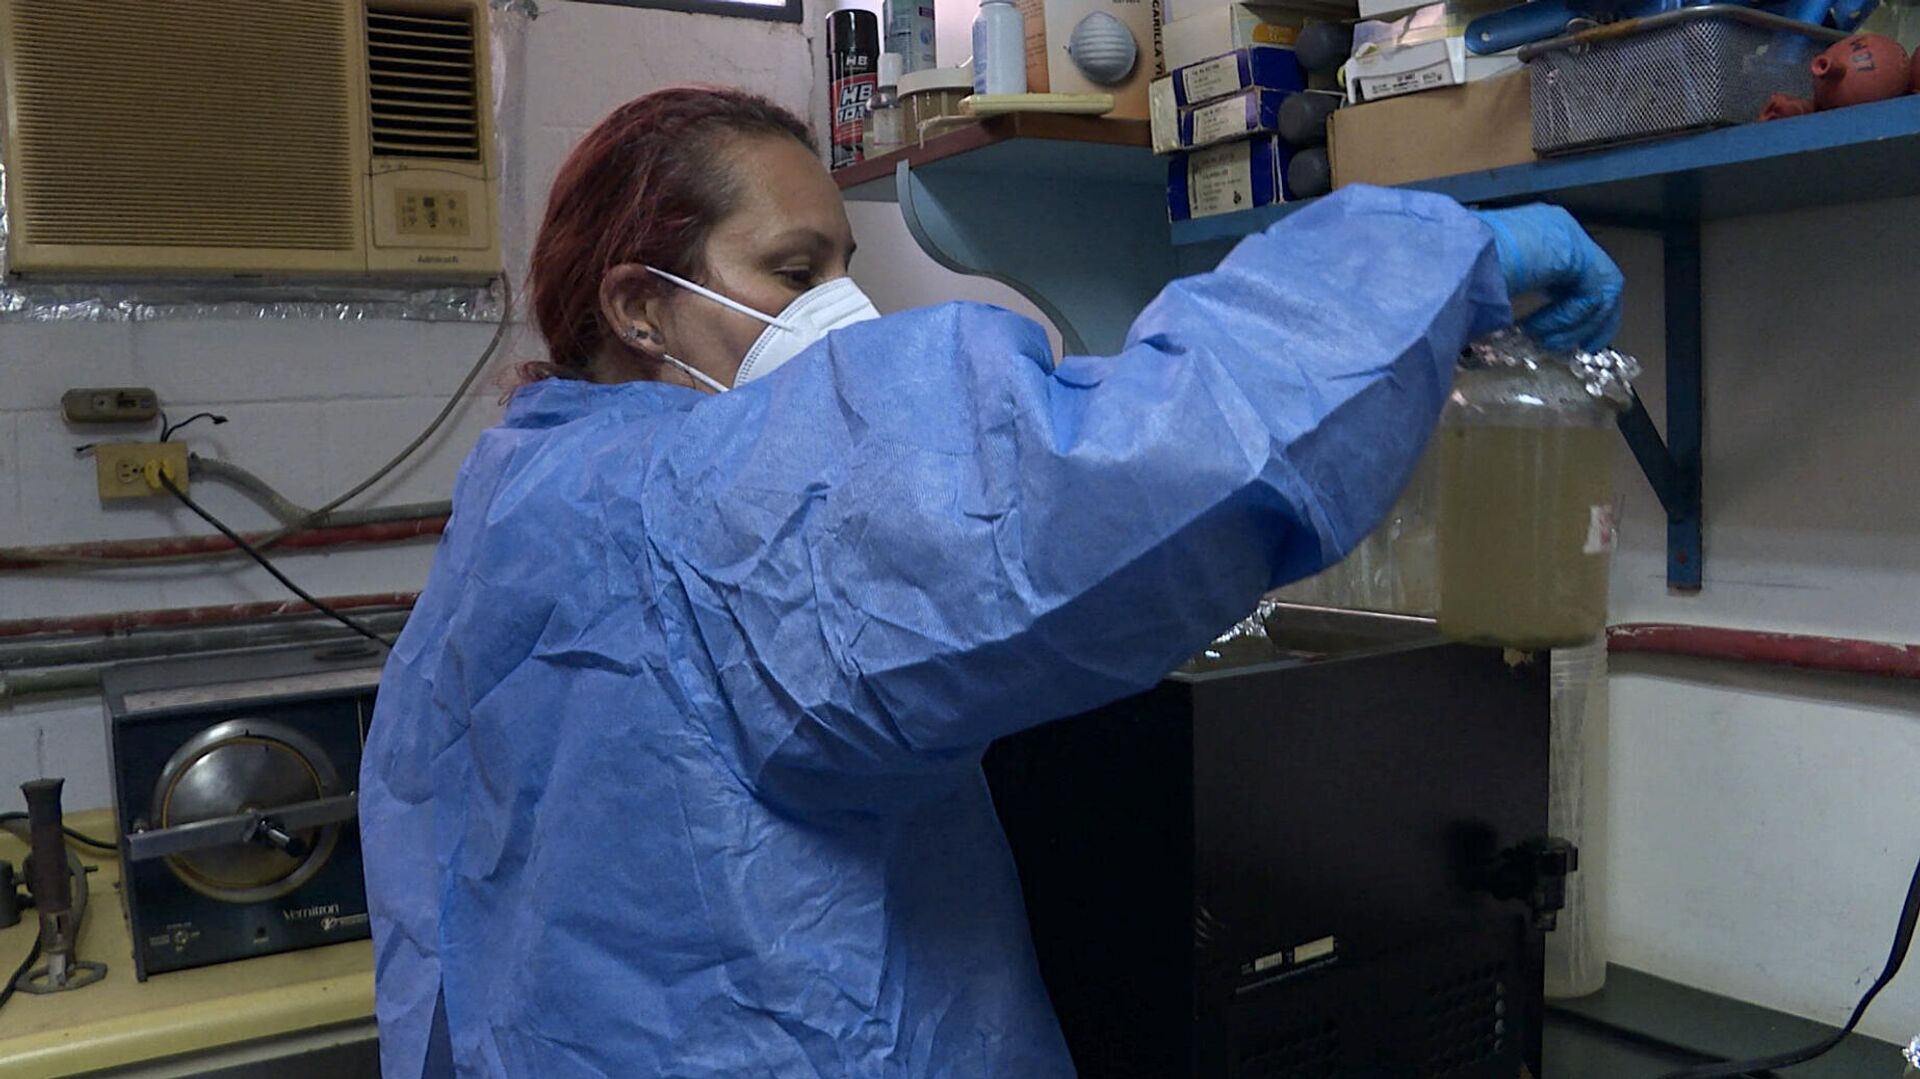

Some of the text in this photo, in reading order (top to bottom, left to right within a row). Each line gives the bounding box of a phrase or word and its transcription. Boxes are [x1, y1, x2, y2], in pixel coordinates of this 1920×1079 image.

[846, 55, 868, 66] HB
[842, 83, 873, 106] HB
[282, 903, 340, 920] Vernitron
